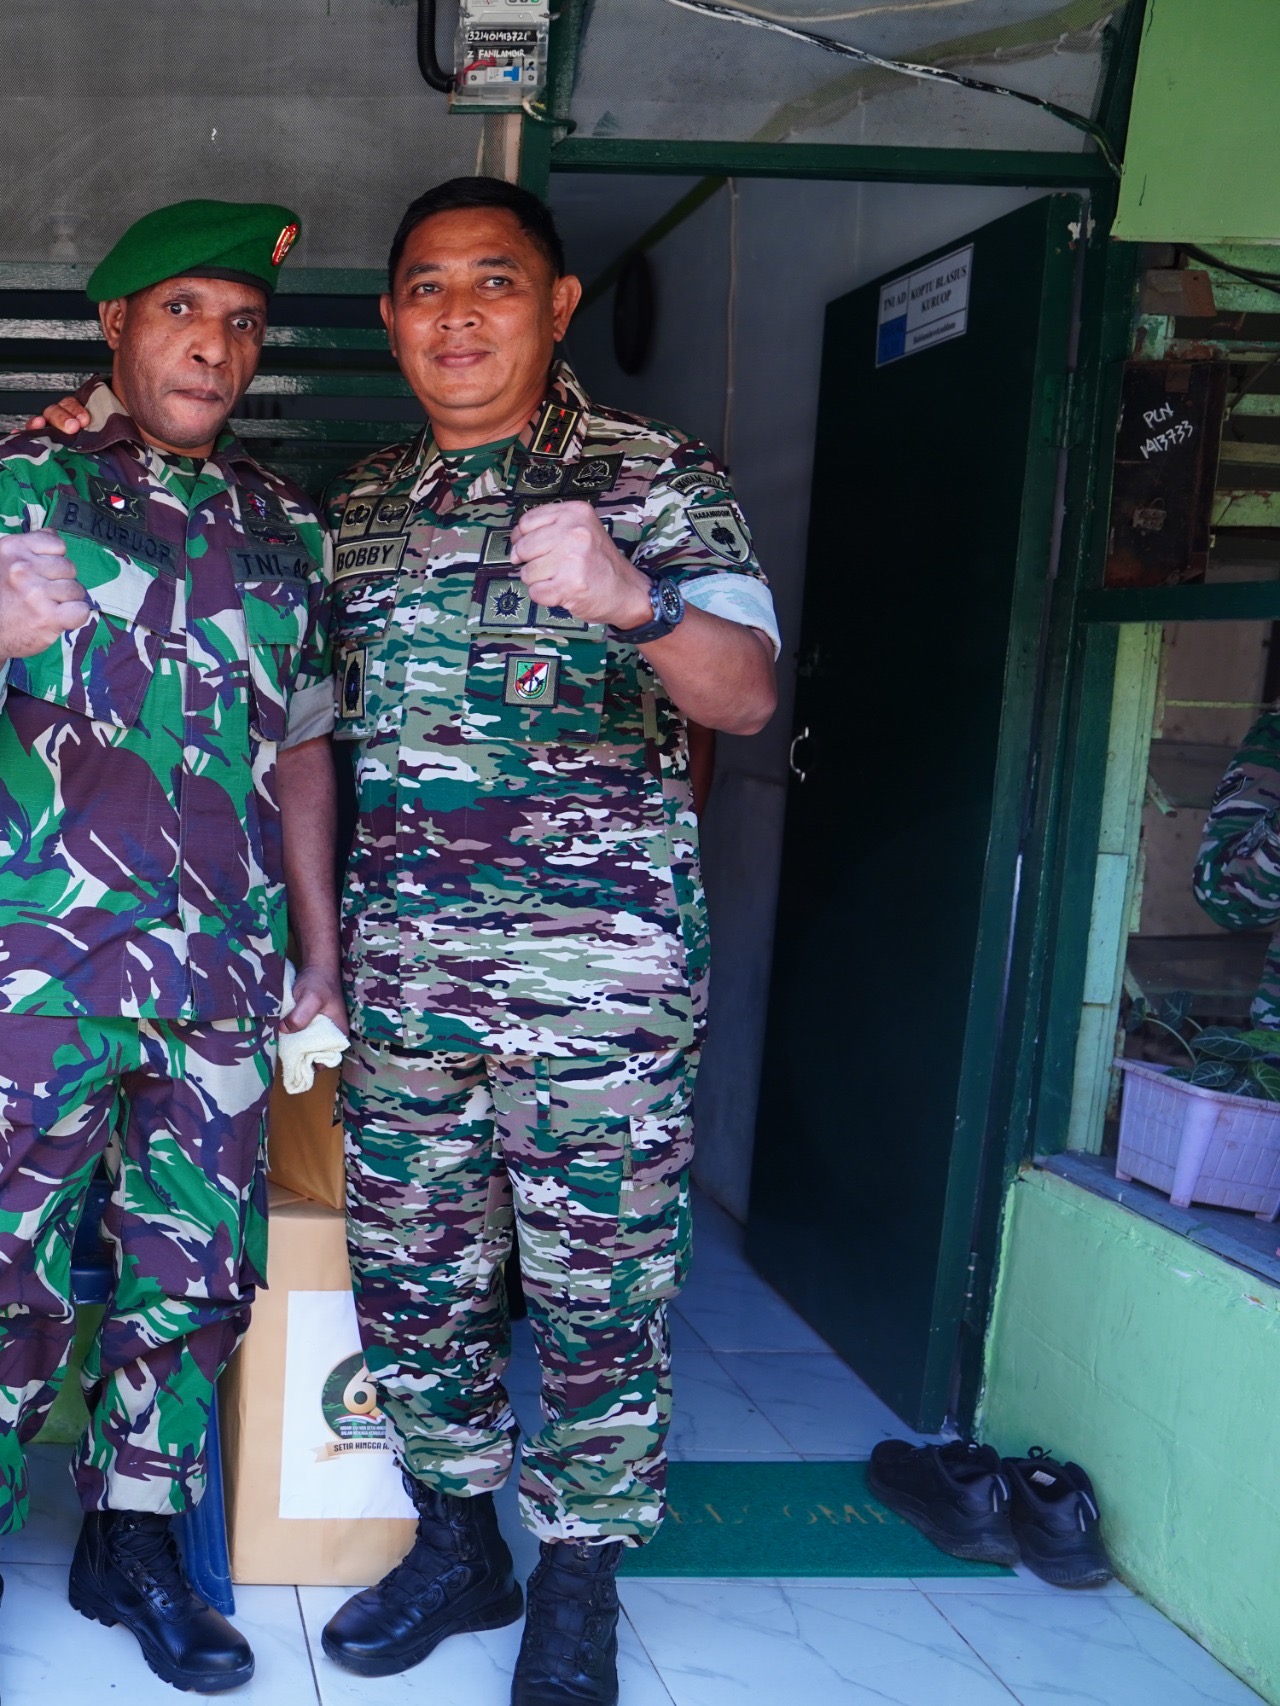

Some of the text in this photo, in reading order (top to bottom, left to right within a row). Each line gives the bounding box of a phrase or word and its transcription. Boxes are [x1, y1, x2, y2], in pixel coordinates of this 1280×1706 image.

[910, 265, 967, 301] KOPTU BLASIUS
[921, 289, 952, 313] KURUOP
[1143, 402, 1174, 430] PLN
[337, 544, 394, 572] BOBBY
[334, 1443, 353, 1452] SETIA
[356, 1442, 381, 1450] HINGGA
